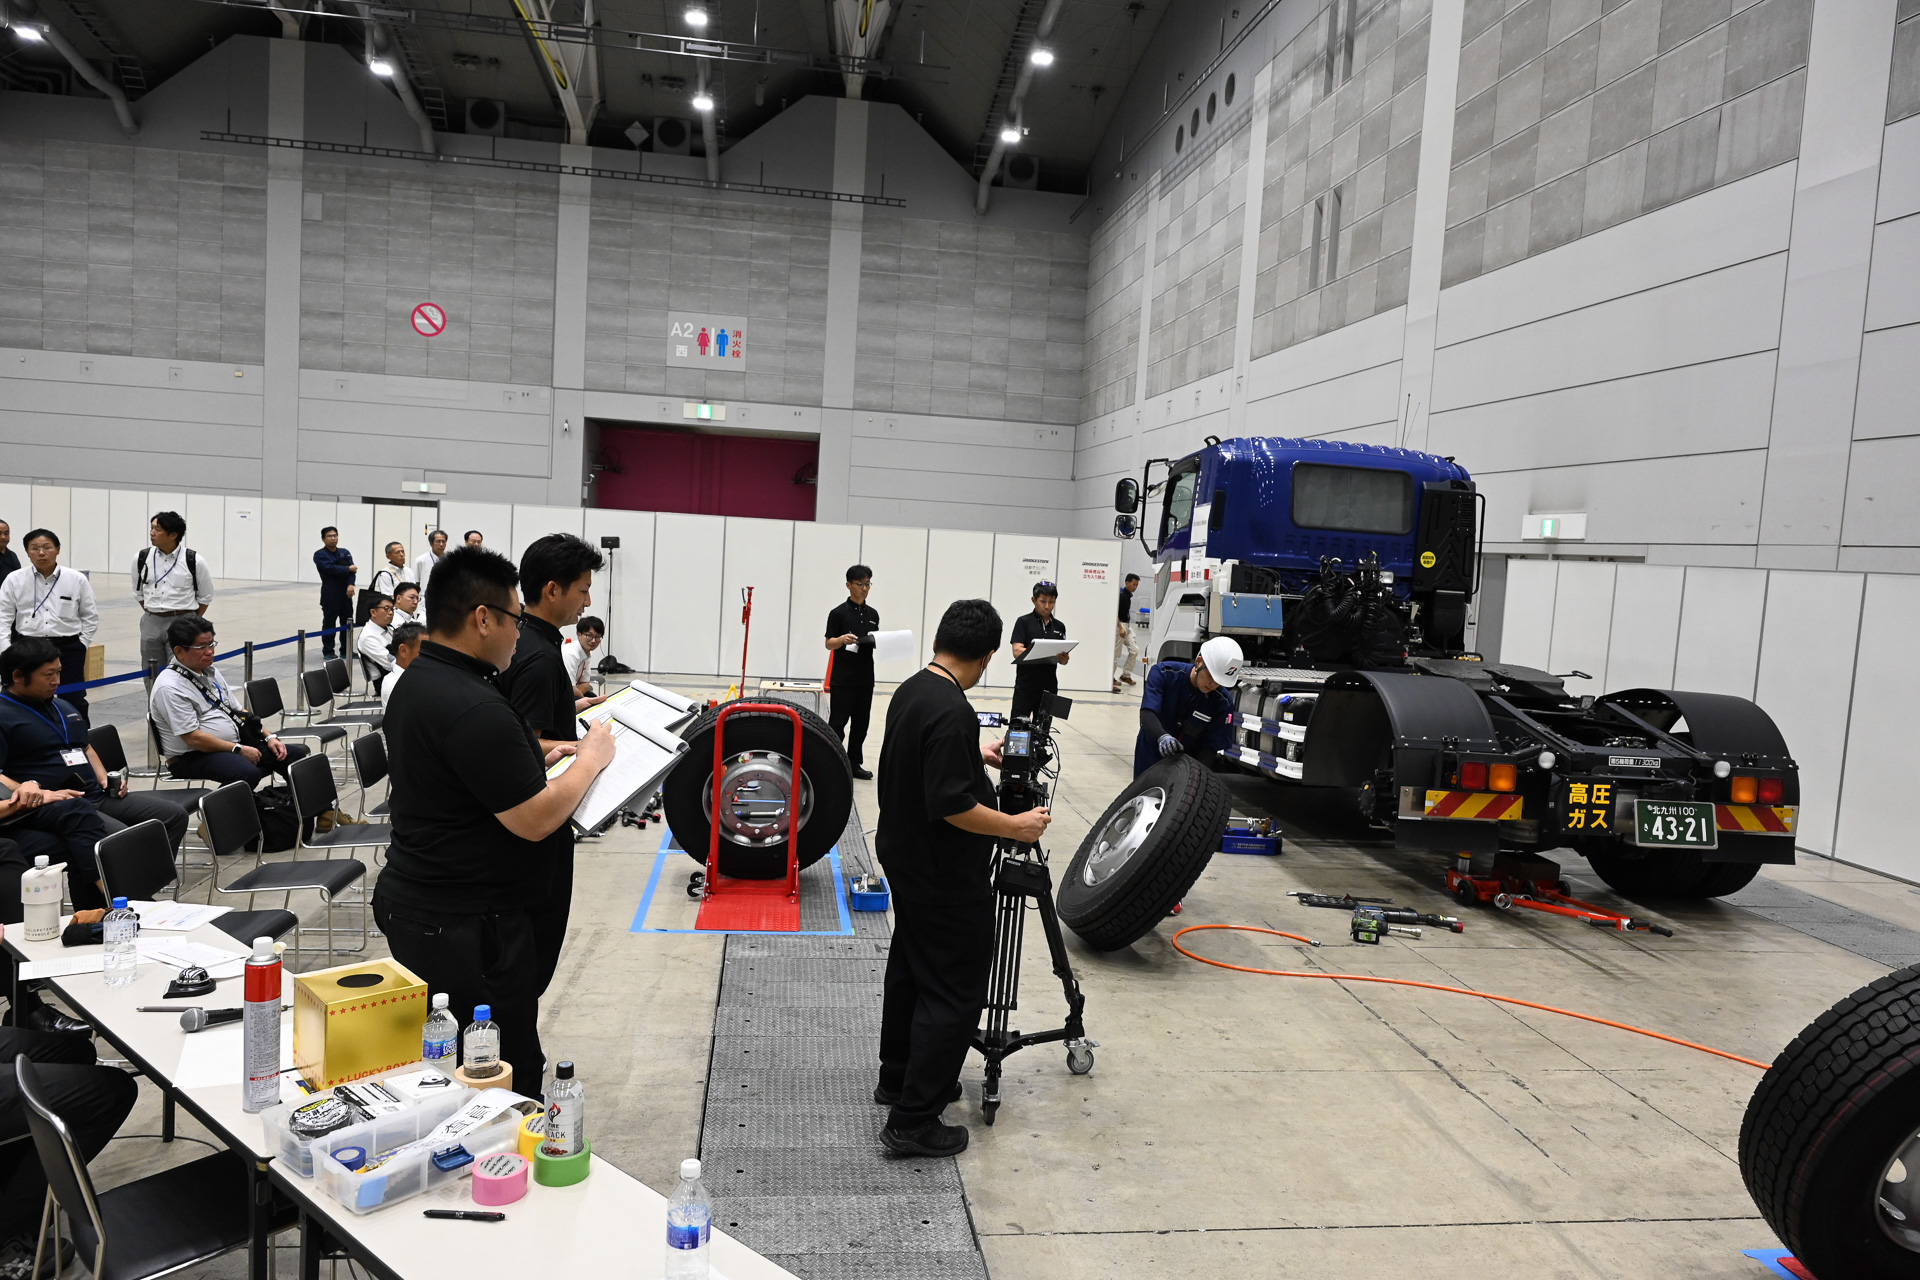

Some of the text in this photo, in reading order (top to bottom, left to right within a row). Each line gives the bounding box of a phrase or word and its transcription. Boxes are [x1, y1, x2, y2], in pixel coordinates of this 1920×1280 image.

[670, 322, 694, 338] A2
[675, 345, 688, 357] 西
[732, 329, 742, 359] 消火栓
[1568, 782, 1611, 805] 高圧
[1567, 808, 1608, 829] ガス
[1652, 805, 1695, 816] 北九州 100
[1652, 815, 1707, 842] 43-21
[347, 1060, 408, 1083] LUCKY BOX
